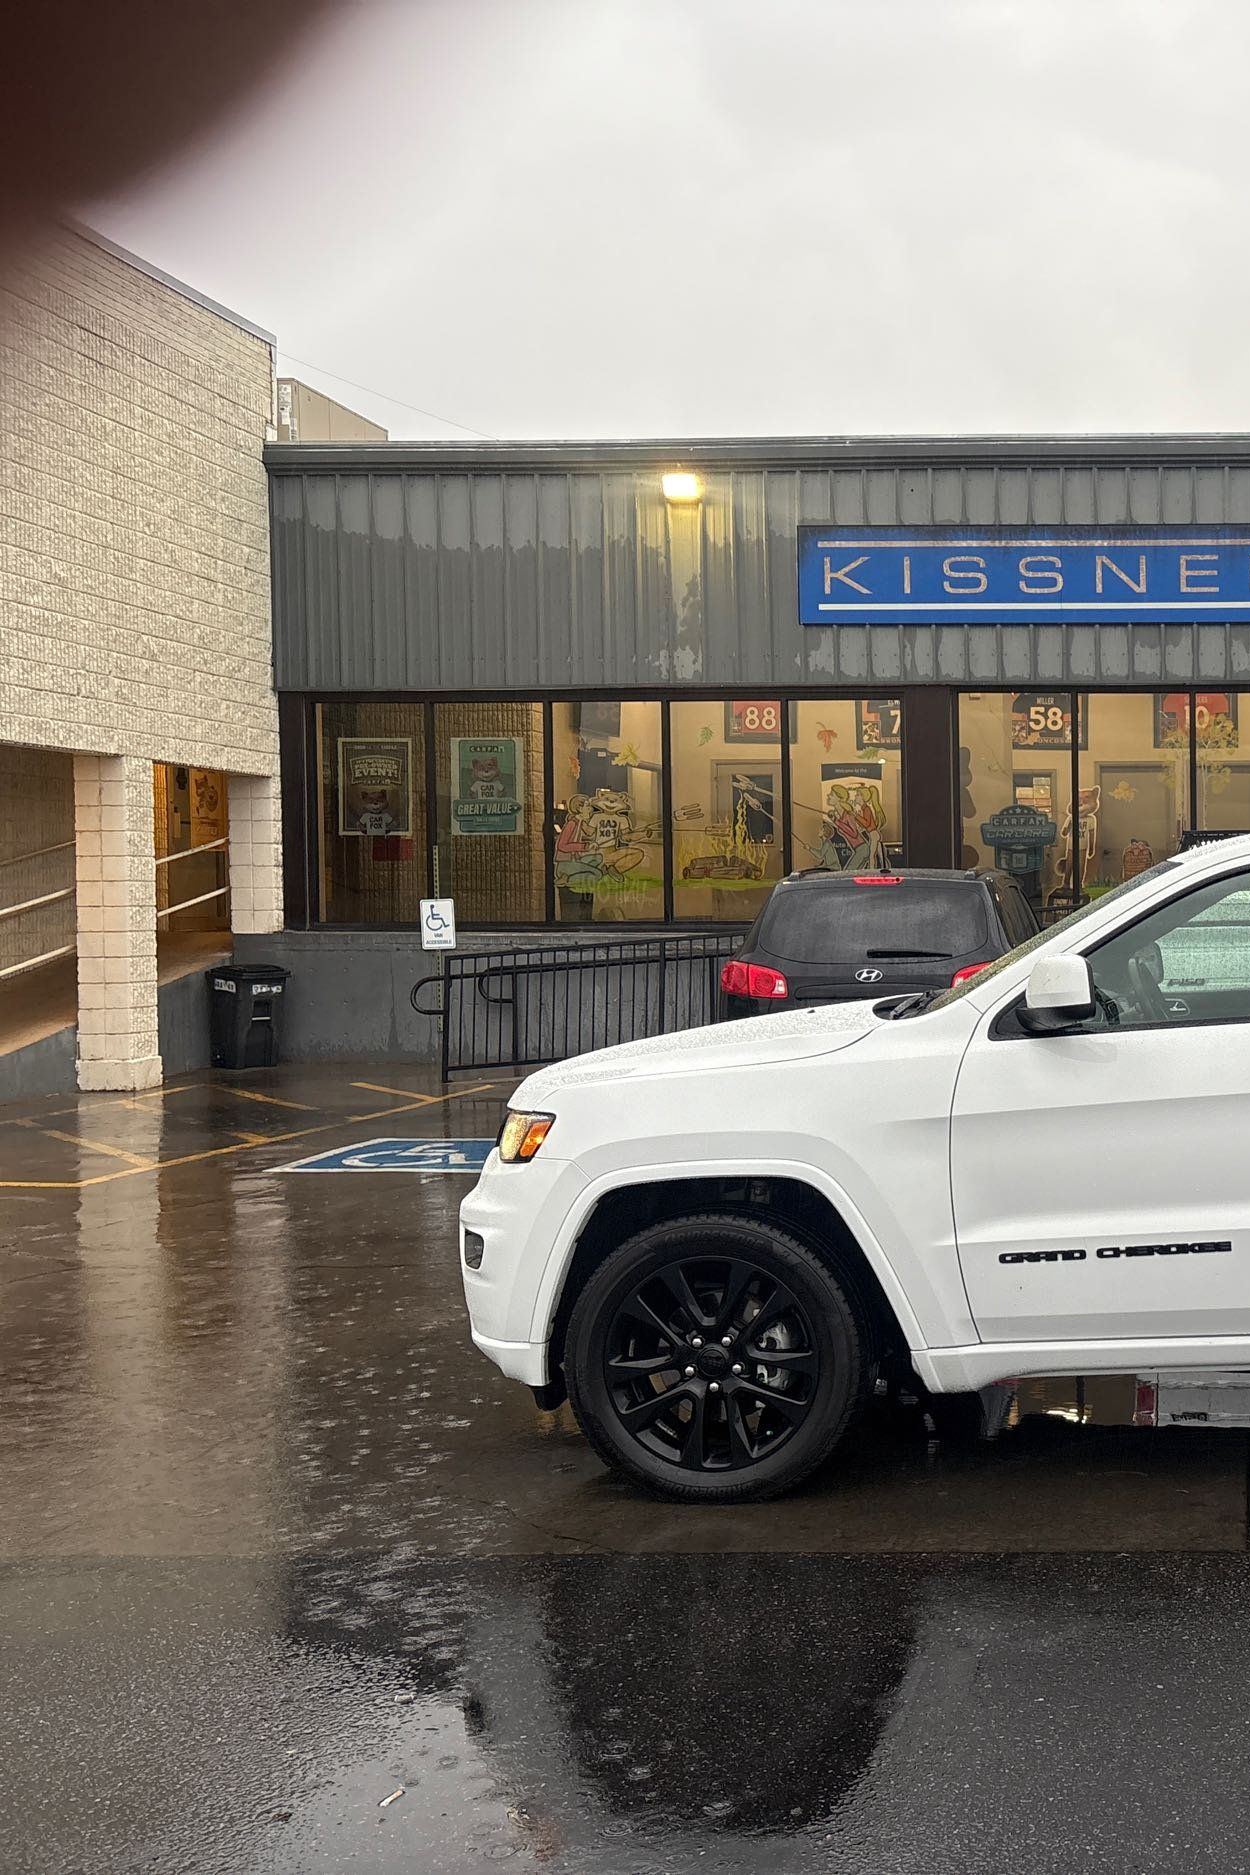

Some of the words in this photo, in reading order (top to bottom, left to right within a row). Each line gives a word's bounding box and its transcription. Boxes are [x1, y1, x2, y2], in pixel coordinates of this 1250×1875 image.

[1036, 696, 1055, 705] MILLER
[744, 706, 776, 730] 88
[1028, 706, 1063, 731] 58
[354, 768, 398, 778] EVENT!
[457, 803, 484, 816] GREAT
[486, 802, 512, 815] VALUE
[993, 817, 1046, 826] CARFAX
[999, 1249, 1087, 1264] GRAND
[1097, 1241, 1233, 1259] CHEROKEE
